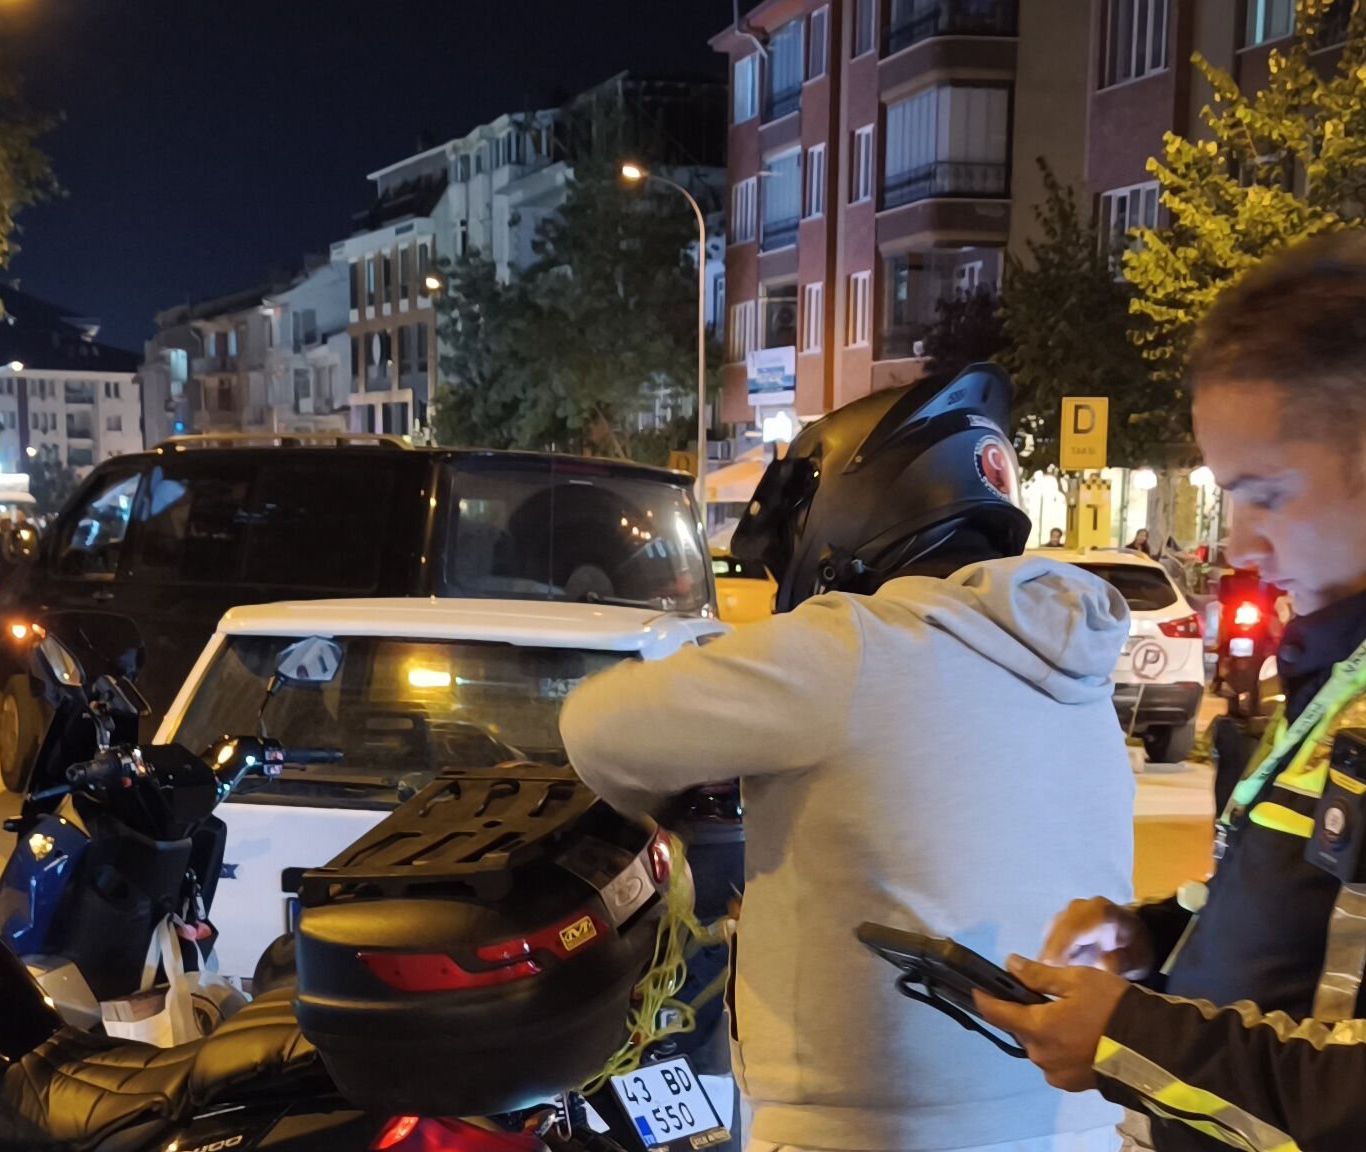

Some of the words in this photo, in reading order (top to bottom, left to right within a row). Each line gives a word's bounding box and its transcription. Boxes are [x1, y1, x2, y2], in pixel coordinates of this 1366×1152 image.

[1073, 404, 1095, 434] D
[1086, 504, 1104, 531] T
[622, 1076, 653, 1105] 43
[660, 1066, 692, 1096] BD
[651, 1102, 696, 1134] 550
